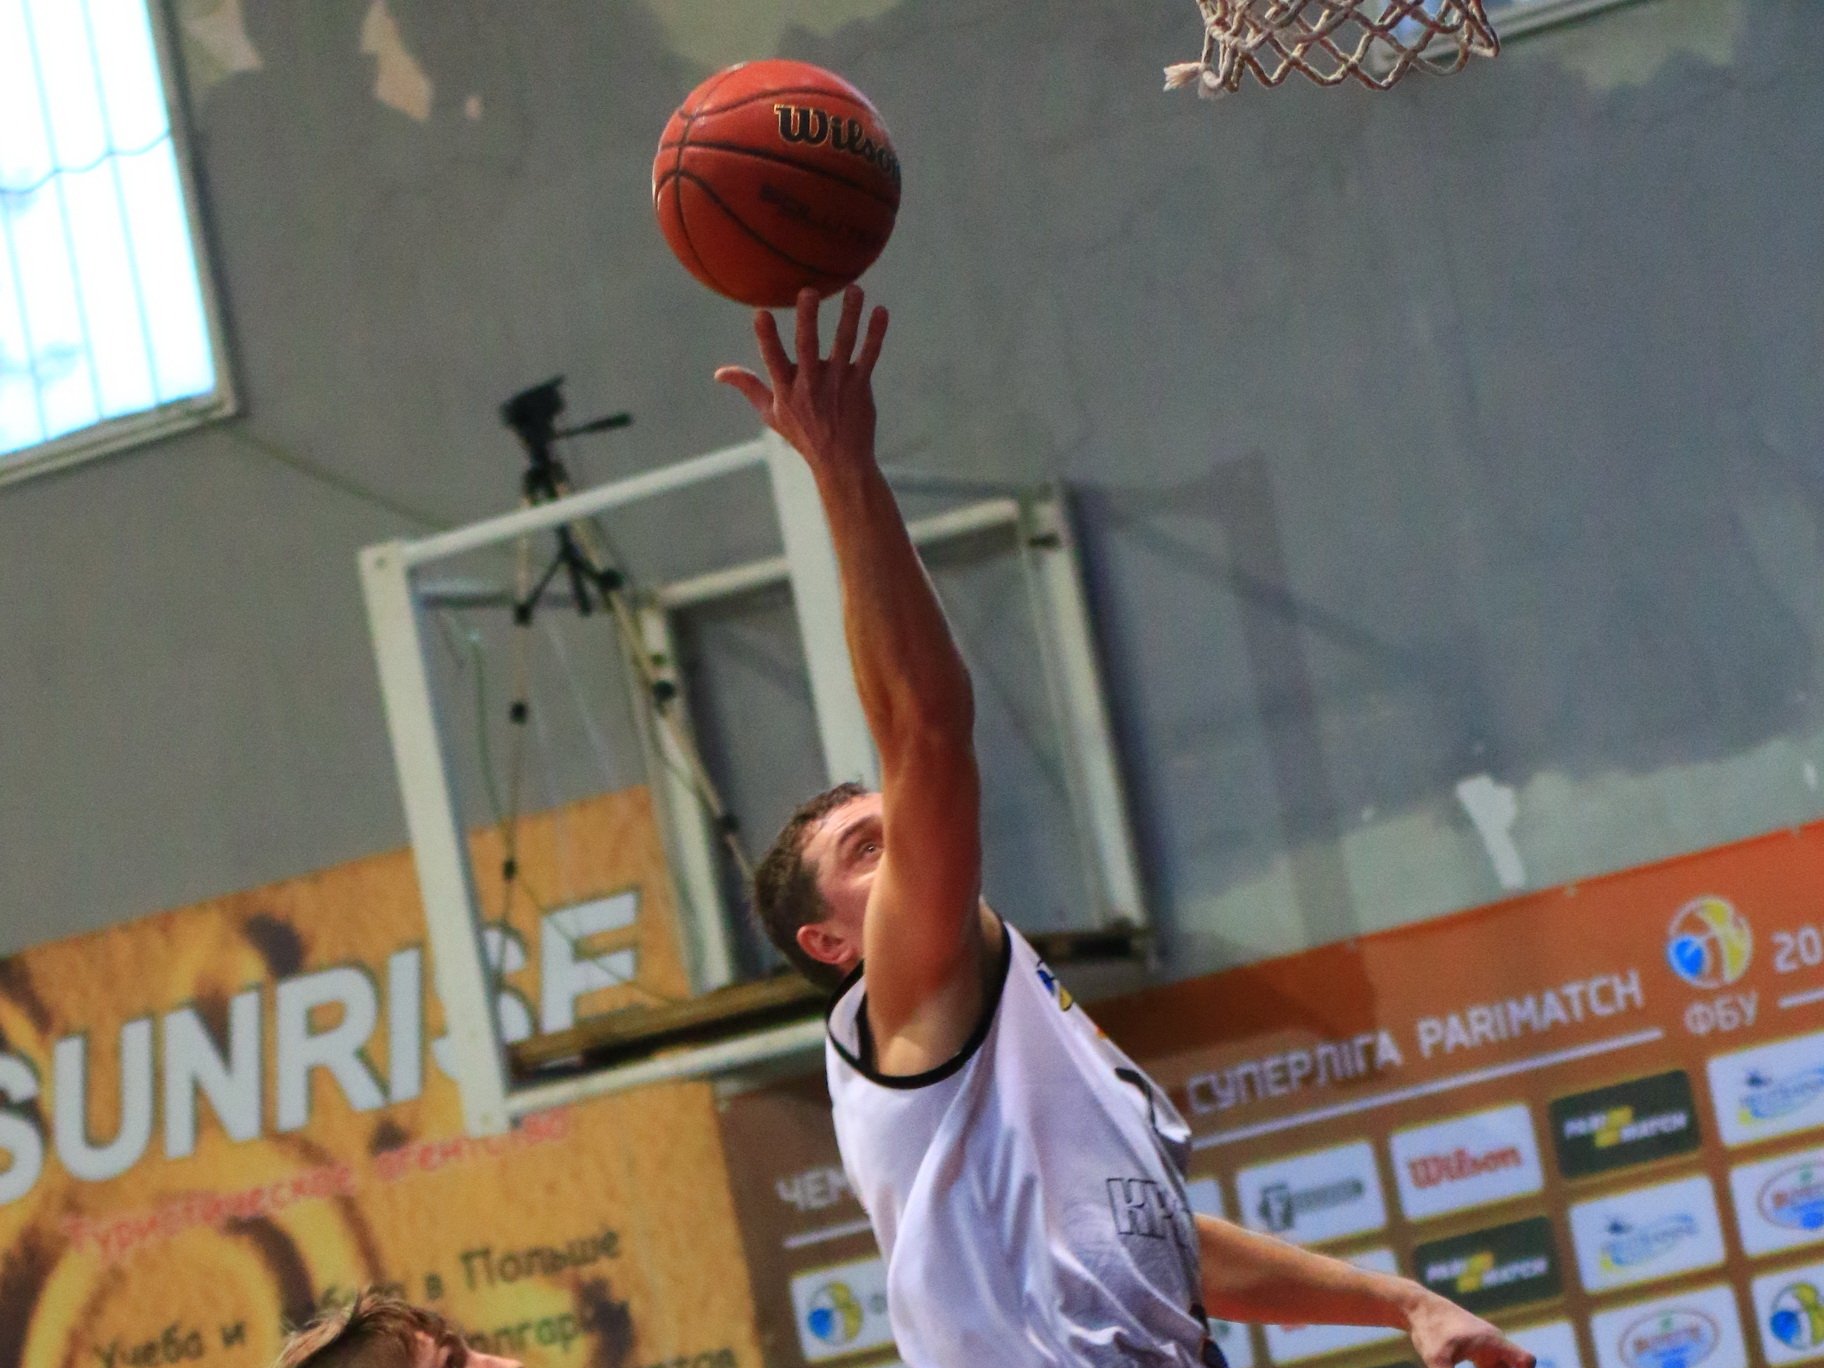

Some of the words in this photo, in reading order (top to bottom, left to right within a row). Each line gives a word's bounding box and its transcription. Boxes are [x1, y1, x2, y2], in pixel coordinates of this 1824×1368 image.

[1416, 968, 1645, 1059] PARIMATCH
[1683, 991, 1759, 1036] ФБУ
[1407, 1144, 1523, 1191] Wilson
[460, 1230, 622, 1292] Польше
